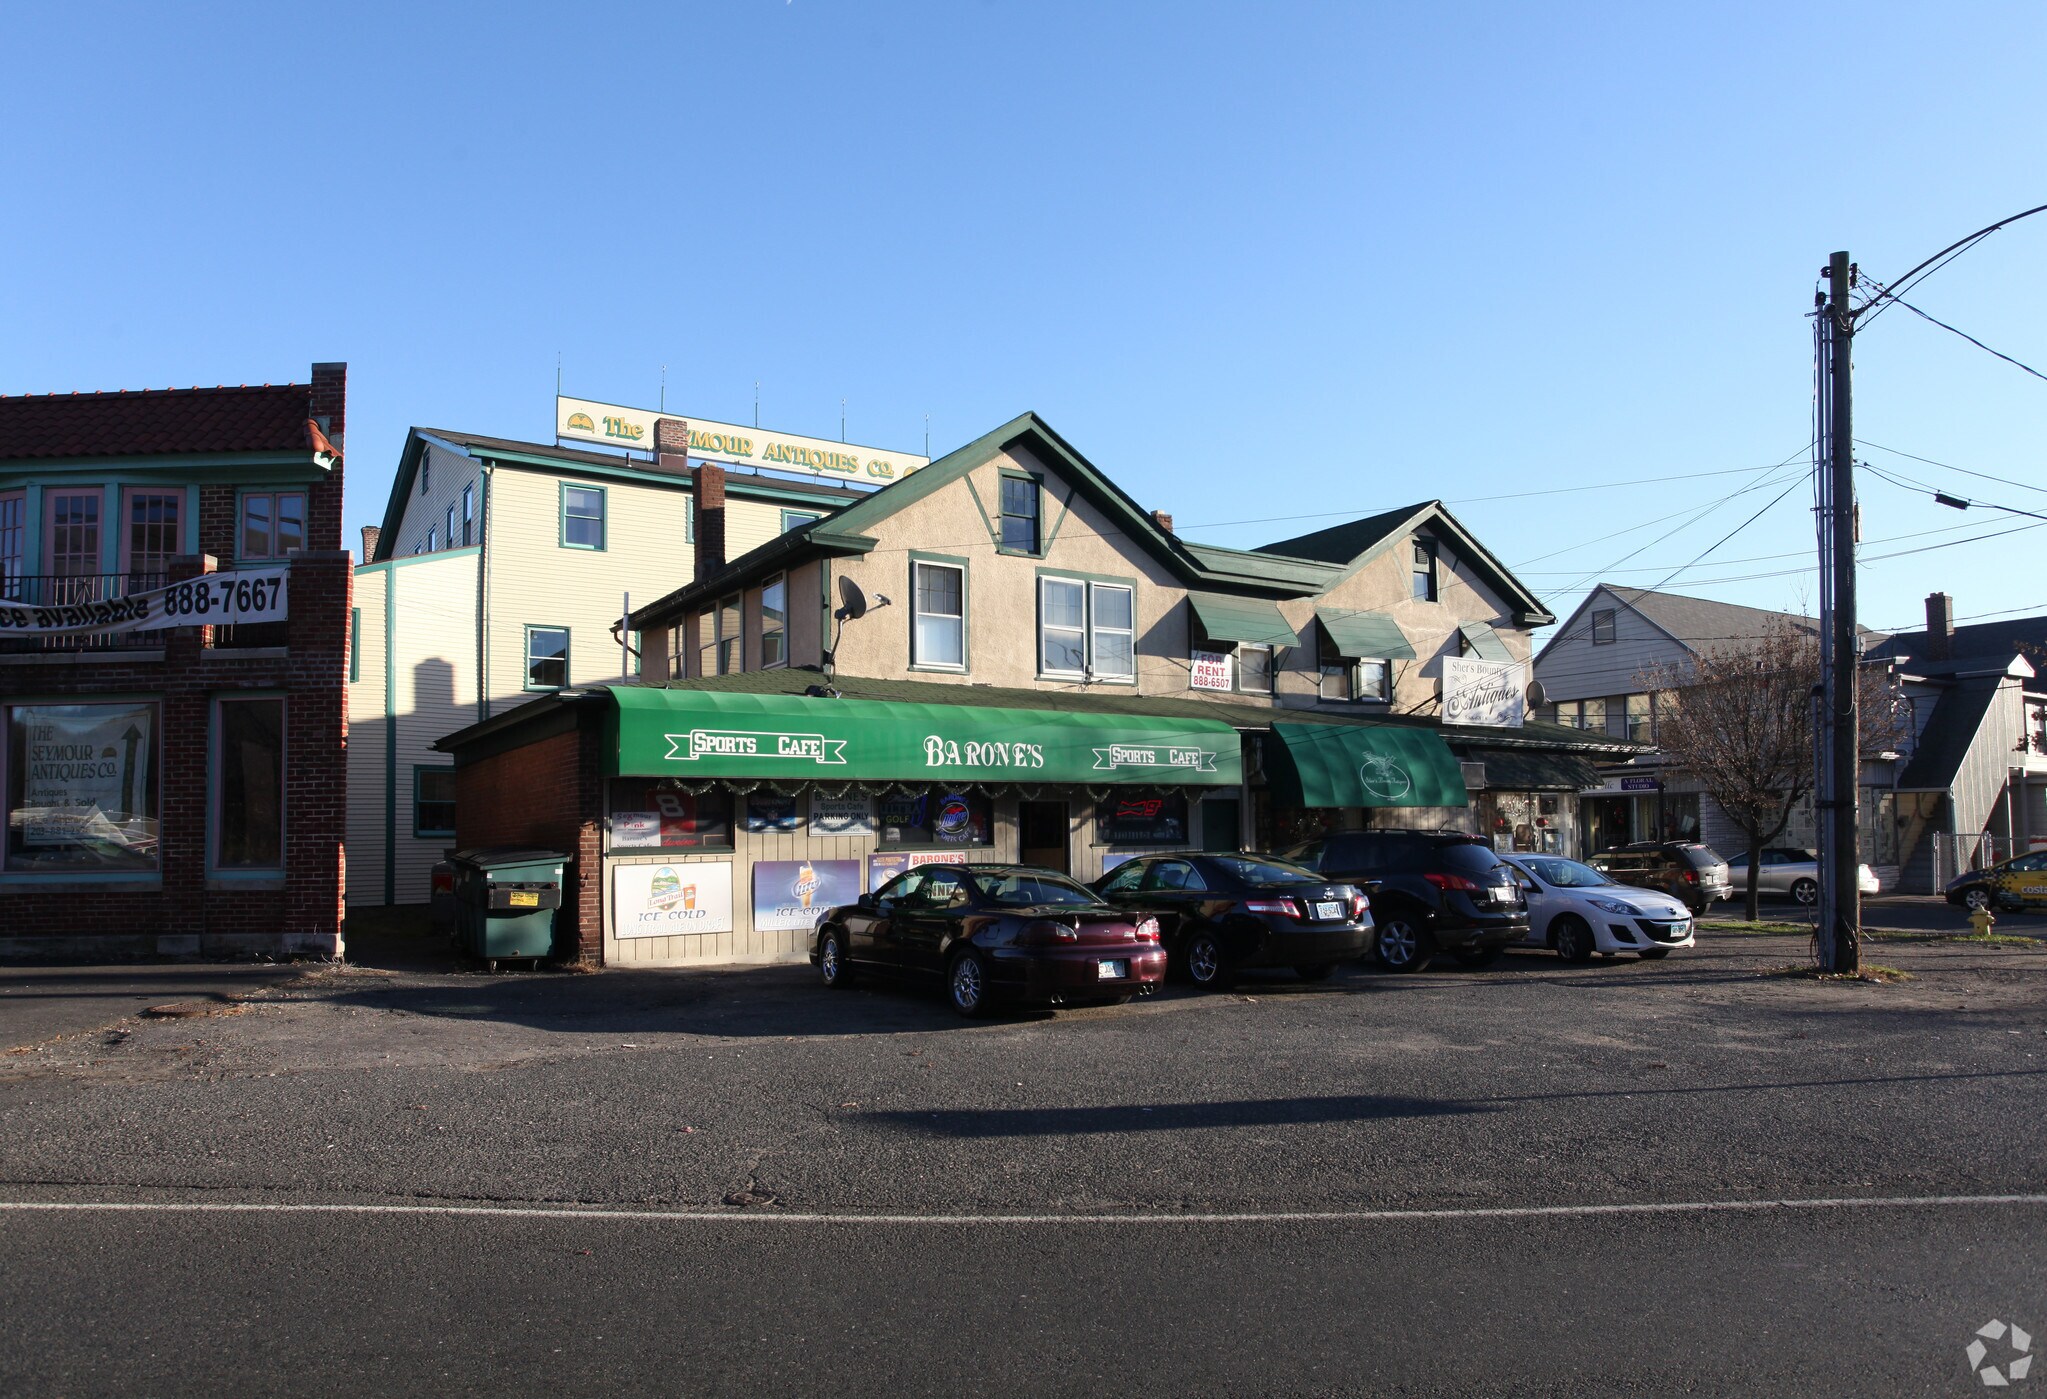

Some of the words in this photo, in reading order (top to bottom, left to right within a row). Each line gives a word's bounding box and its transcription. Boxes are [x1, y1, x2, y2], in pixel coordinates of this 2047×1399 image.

[603, 415, 645, 441] The
[686, 430, 754, 457] YMOUR
[762, 442, 860, 475] ANTIQUES
[35, 596, 150, 628] available
[164, 577, 281, 617] 888-7667
[1201, 654, 1222, 665] FOR
[1197, 665, 1225, 677] RENT
[1452, 661, 1475, 674] Sher's
[1477, 664, 1503, 677] Bounty
[1448, 677, 1520, 720] Antiques
[32, 725, 54, 741] THE
[694, 733, 757, 753] SPORTS
[778, 736, 821, 755] CAFE
[923, 735, 1045, 769] BARONE'S
[32, 744, 93, 761] SEYMOUR
[1112, 747, 1156, 764] SPORTS
[1169, 749, 1199, 765] CAFE
[31, 762, 97, 782] ANTIQUES
[31, 788, 68, 798] Antiques
[75, 797, 96, 807] Sold
[656, 794, 685, 817] 8
[814, 812, 848, 820] PARKING
[851, 812, 869, 820] ONLY
[886, 815, 910, 823] GOLF
[912, 853, 965, 866] BARONE'S
[667, 892, 683, 903] Trail
[639, 912, 662, 921] ICE
[668, 909, 706, 920] COLD
